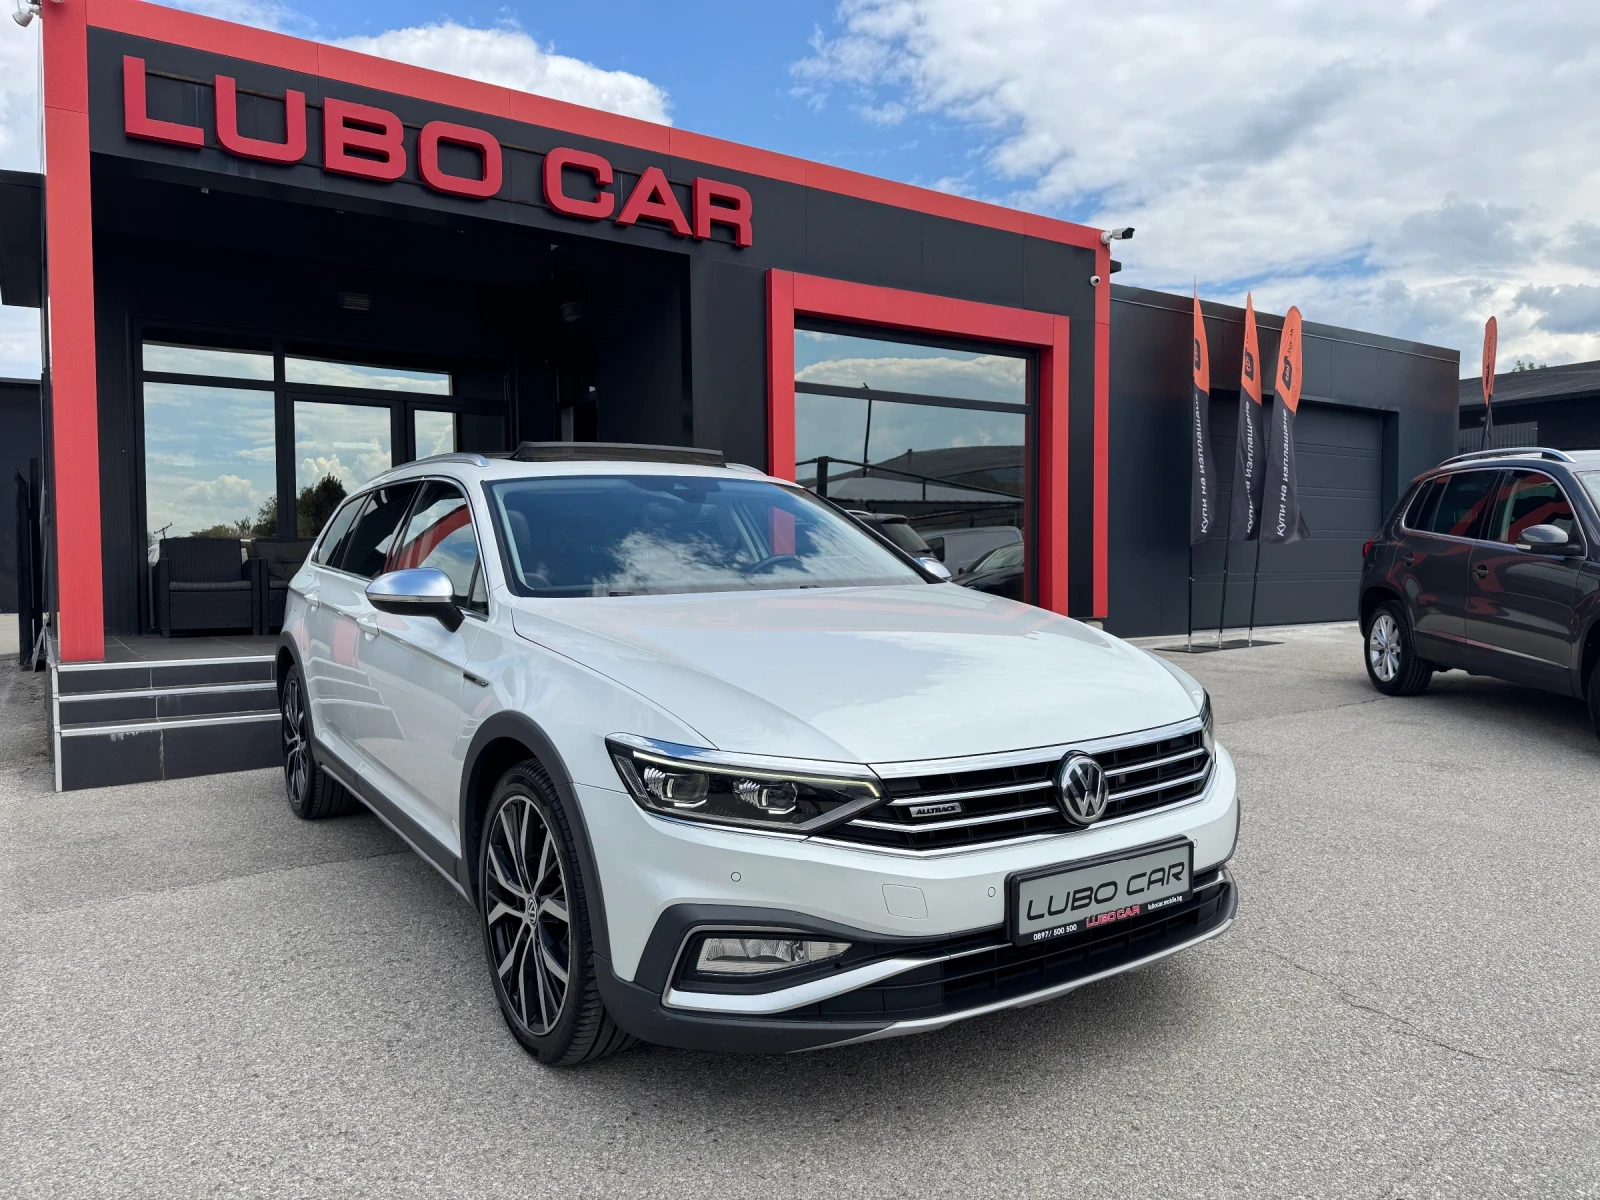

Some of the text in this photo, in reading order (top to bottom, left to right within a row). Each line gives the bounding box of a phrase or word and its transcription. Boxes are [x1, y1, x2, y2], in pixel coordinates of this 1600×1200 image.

[122, 54, 753, 248] LUBO CAR
[1200, 477, 1207, 495] на
[1280, 484, 1287, 501] на
[1201, 498, 1209, 533] Купи
[1276, 503, 1287, 537] Купи
[915, 803, 957, 816] ALLTRACK
[1026, 861, 1185, 921] LUBO CAR
[1086, 904, 1141, 928] LUBO CAR
[1033, 923, 1078, 941] 0897/ 500 500
